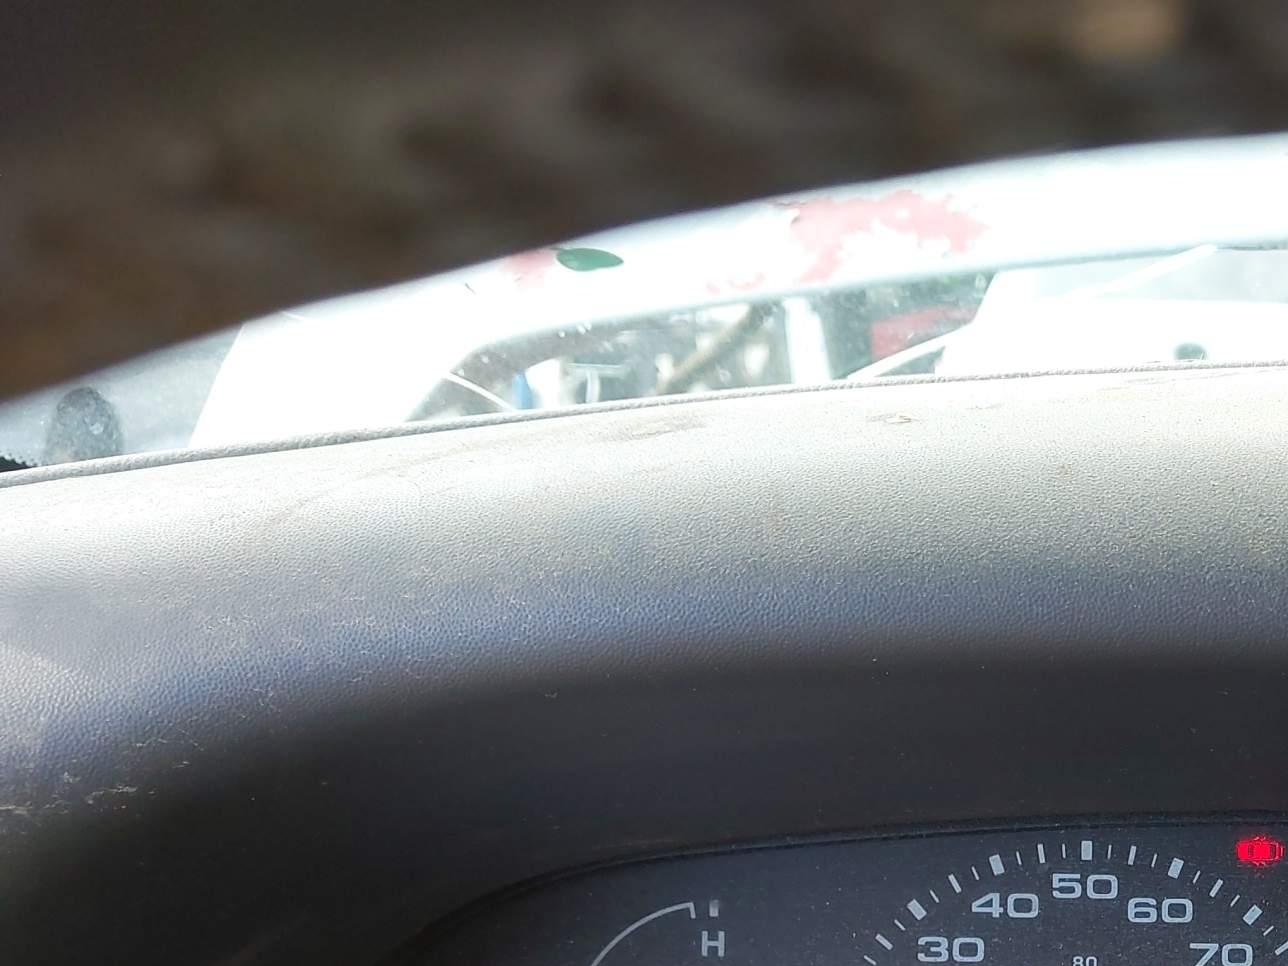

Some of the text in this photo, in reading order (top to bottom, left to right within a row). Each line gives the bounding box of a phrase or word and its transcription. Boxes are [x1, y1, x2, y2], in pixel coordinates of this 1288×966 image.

[1051, 873, 1118, 899] 50
[971, 892, 1039, 918] 40
[1127, 898, 1193, 923] 60
[701, 930, 725, 957] H
[917, 937, 985, 963] 30
